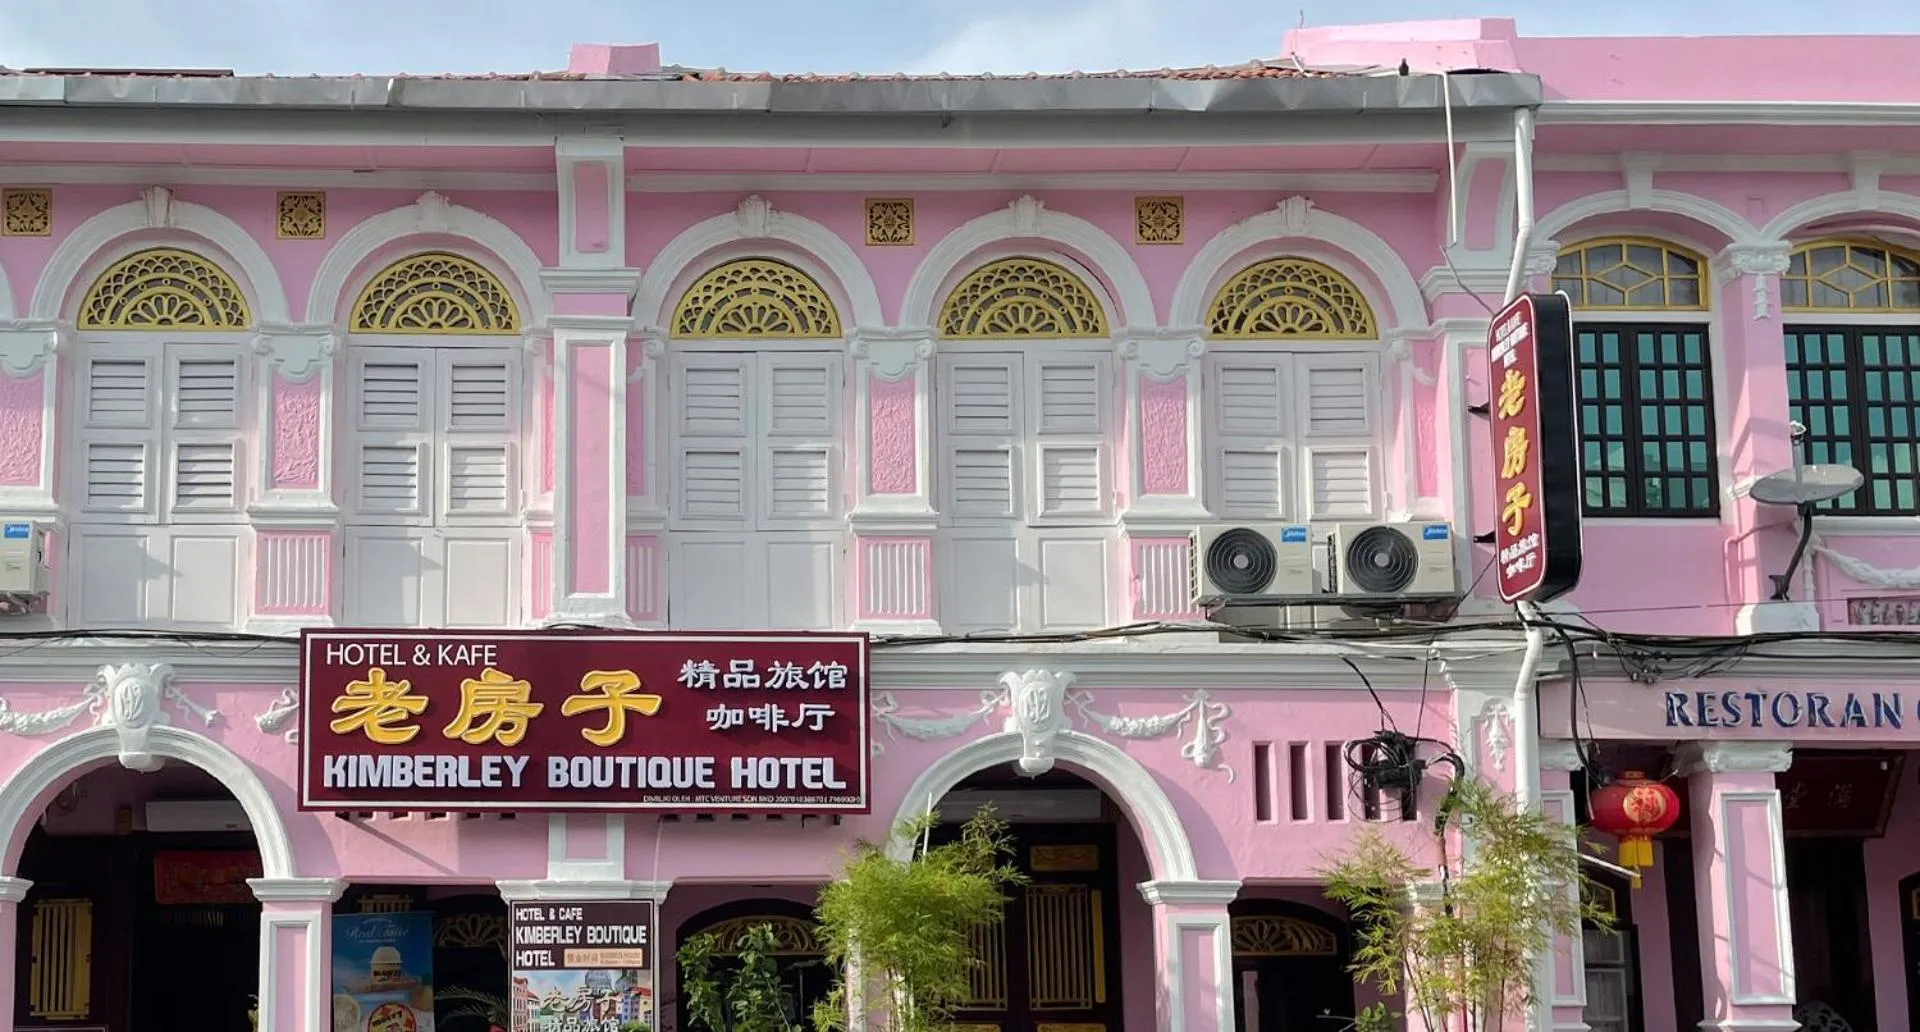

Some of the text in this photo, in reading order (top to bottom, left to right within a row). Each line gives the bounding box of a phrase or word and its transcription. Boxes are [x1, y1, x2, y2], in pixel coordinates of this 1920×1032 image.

[1498, 368, 1532, 537] 老房子
[326, 643, 497, 666] HOTEL & KAFE
[677, 659, 848, 690] 精品旅馆
[329, 667, 663, 747] 老房子
[706, 703, 836, 733] 咖啡厅
[1664, 691, 1904, 729] RESTORAN
[323, 754, 847, 789] KIMBERLEY BOUTIQUE HOTEL
[515, 907, 583, 921] HOTEL & CAFE
[515, 925, 647, 944] KIMBERLEY BOUTIQUE
[516, 950, 555, 967] HOTEL
